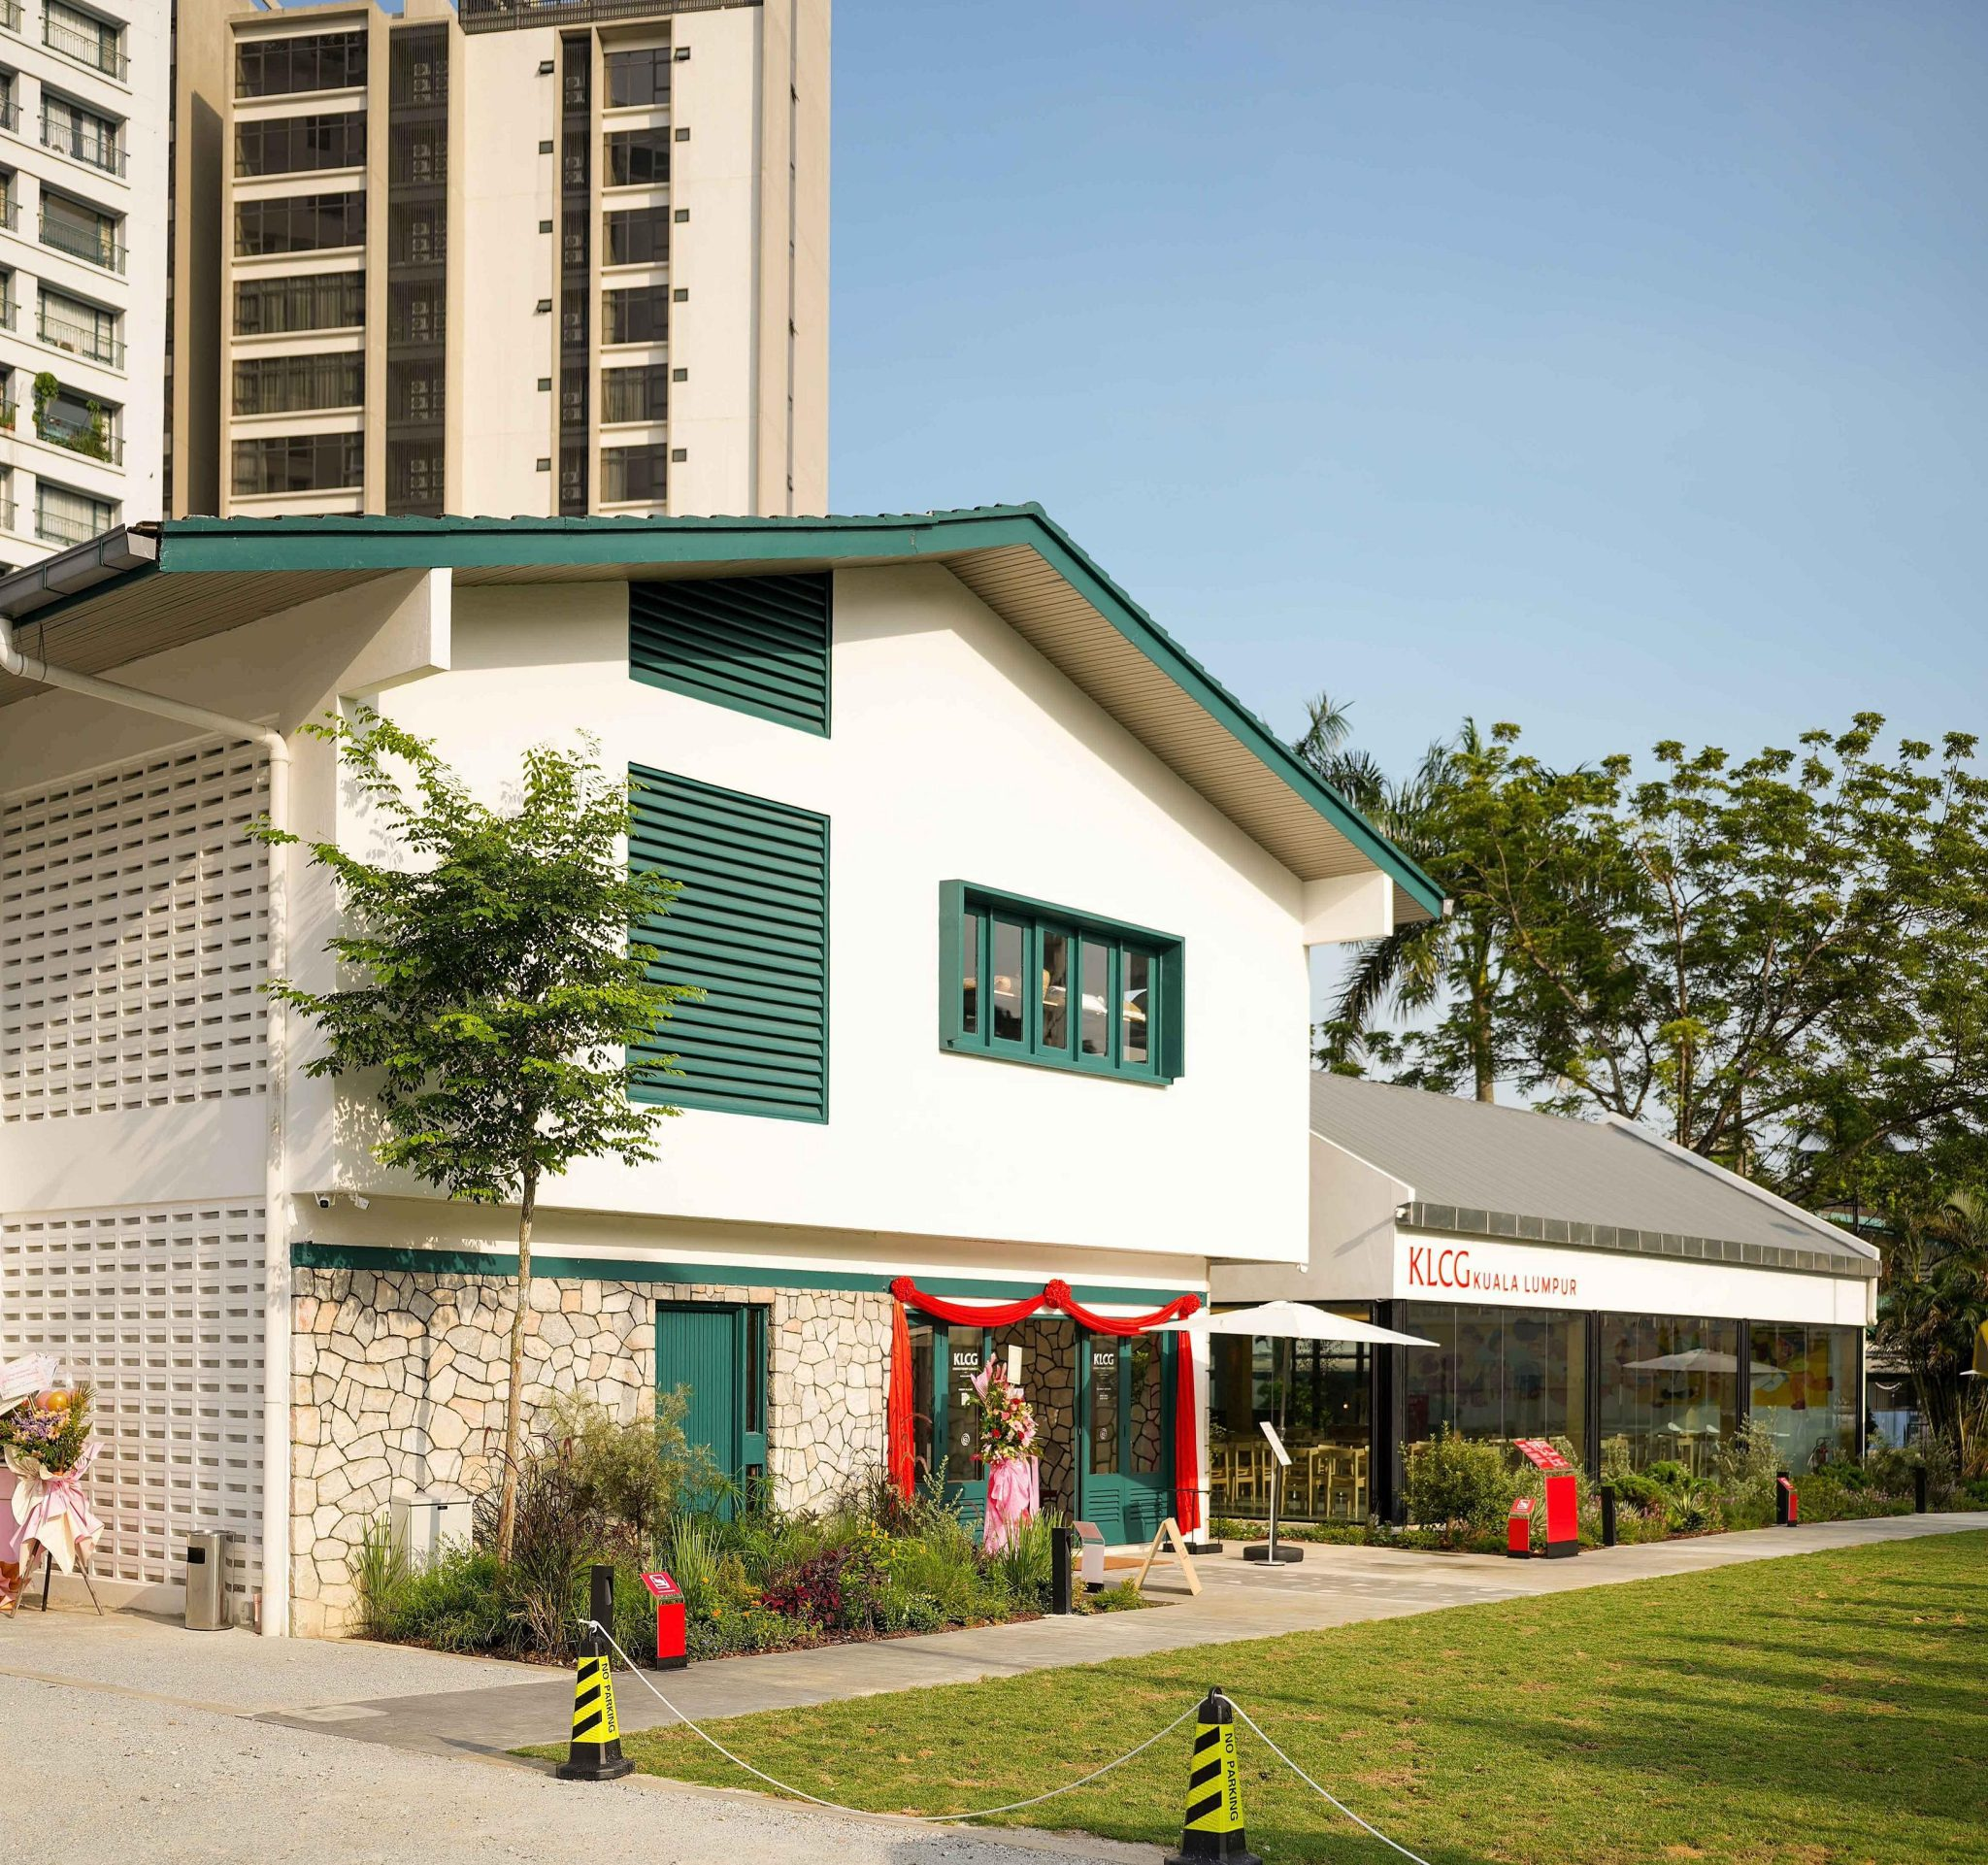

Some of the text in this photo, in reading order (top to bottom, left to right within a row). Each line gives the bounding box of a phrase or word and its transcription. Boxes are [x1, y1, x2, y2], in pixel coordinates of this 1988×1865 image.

[1408, 1247, 1576, 1296] KLCG KUALA LUMPUR
[953, 1352, 978, 1366] KLCG
[1093, 1352, 1114, 1366] KLCG
[601, 1663, 615, 1733] NO PARKING
[1224, 1733, 1239, 1821] NO PARKING
